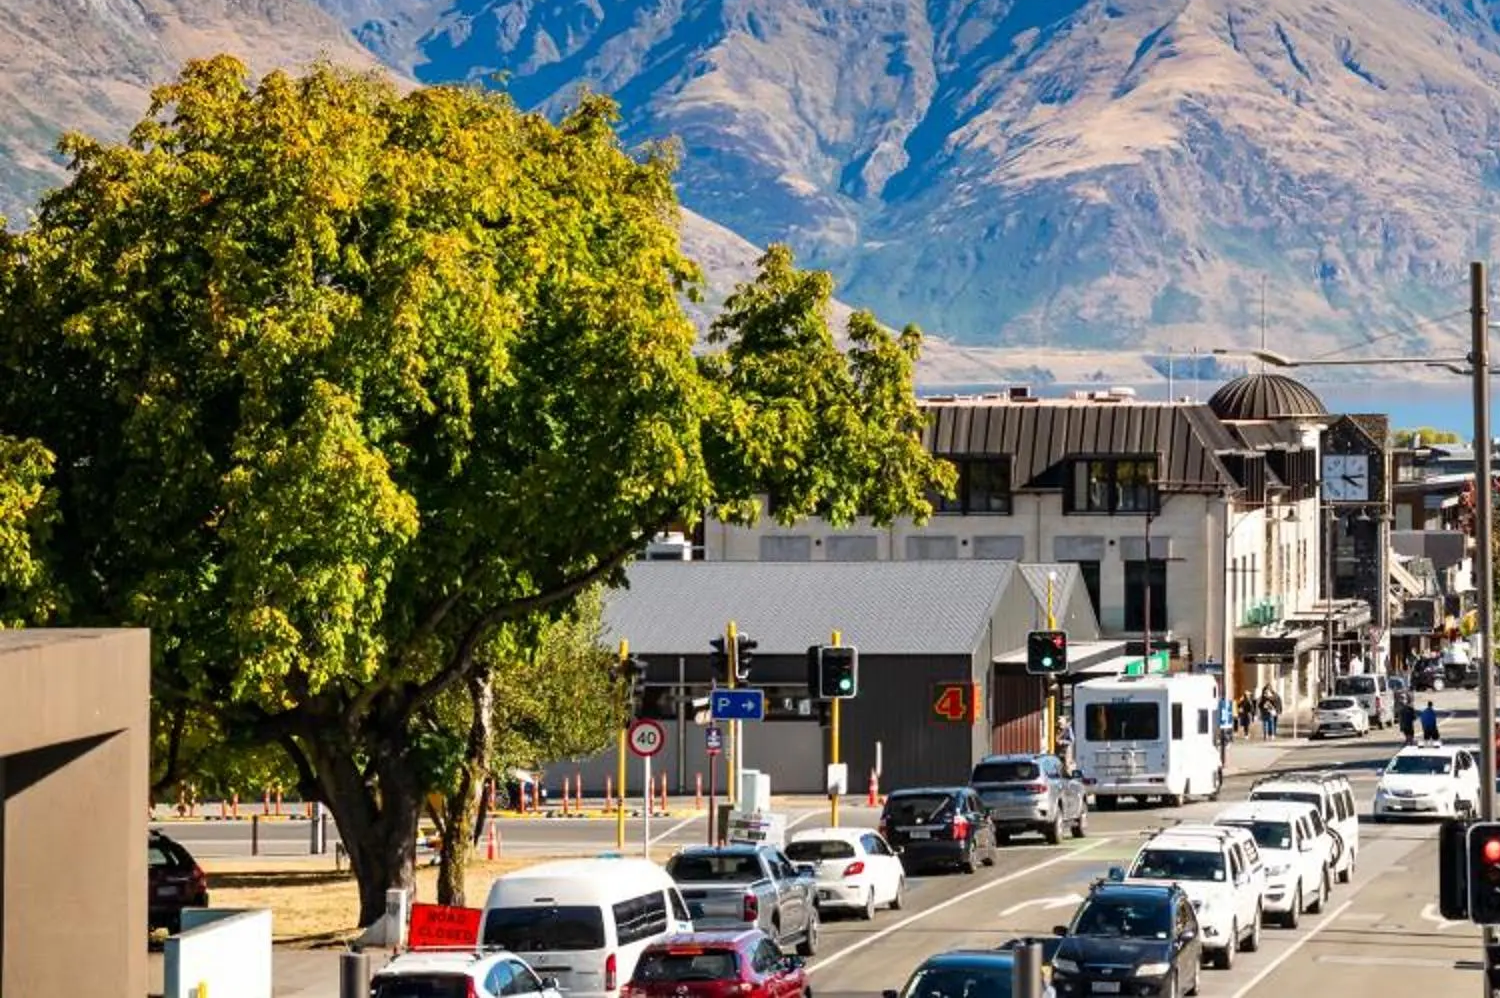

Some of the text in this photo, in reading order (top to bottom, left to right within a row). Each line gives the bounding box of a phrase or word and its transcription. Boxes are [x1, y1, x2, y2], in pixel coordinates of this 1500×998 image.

[717, 697, 731, 713] P
[934, 687, 967, 720] 4
[636, 731, 657, 745] 40
